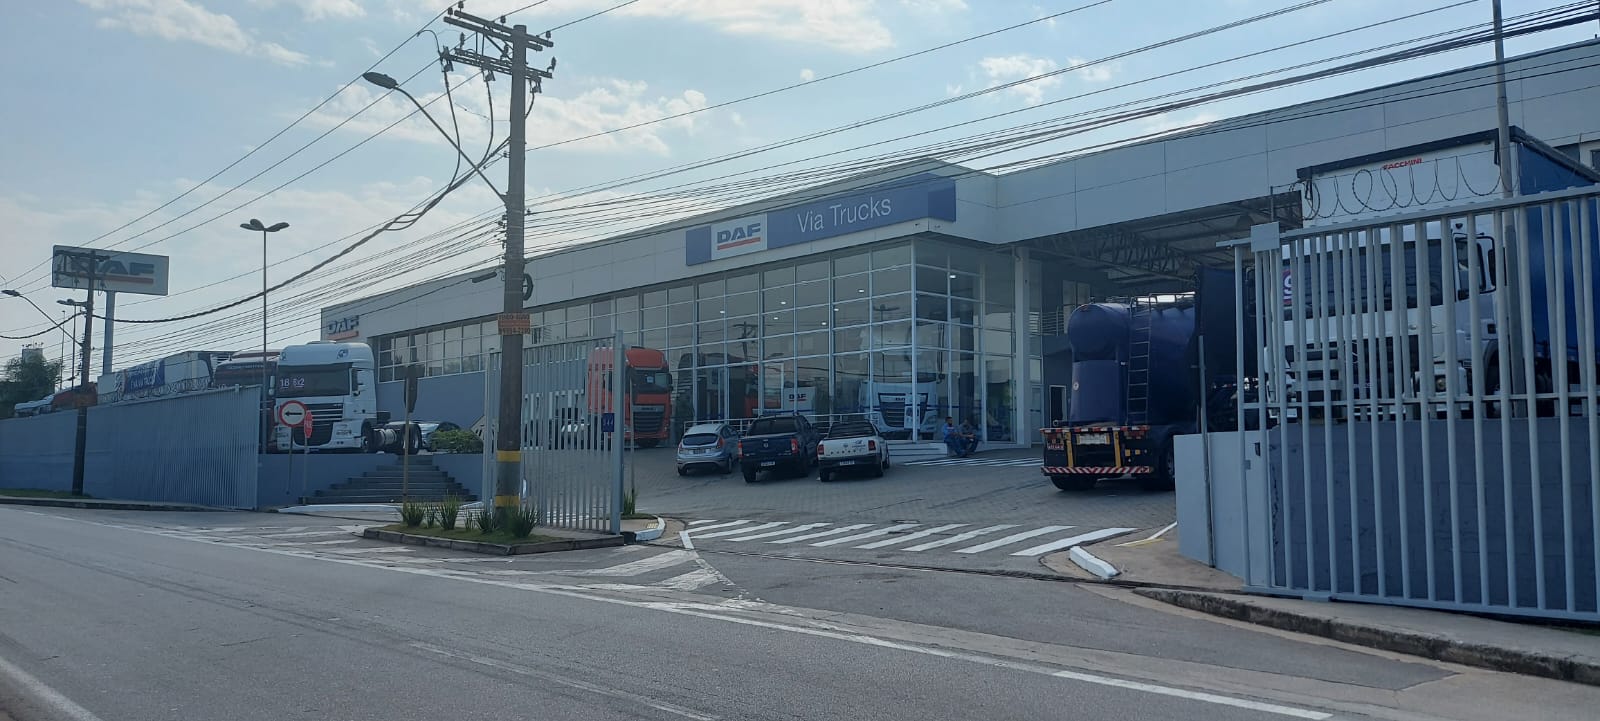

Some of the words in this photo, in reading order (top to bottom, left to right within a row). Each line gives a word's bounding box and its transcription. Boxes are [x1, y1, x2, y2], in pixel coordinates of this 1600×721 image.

[797, 211, 825, 233] Via
[830, 197, 892, 226] Trucks
[717, 222, 761, 244] DAF
[328, 316, 359, 334] DAF
